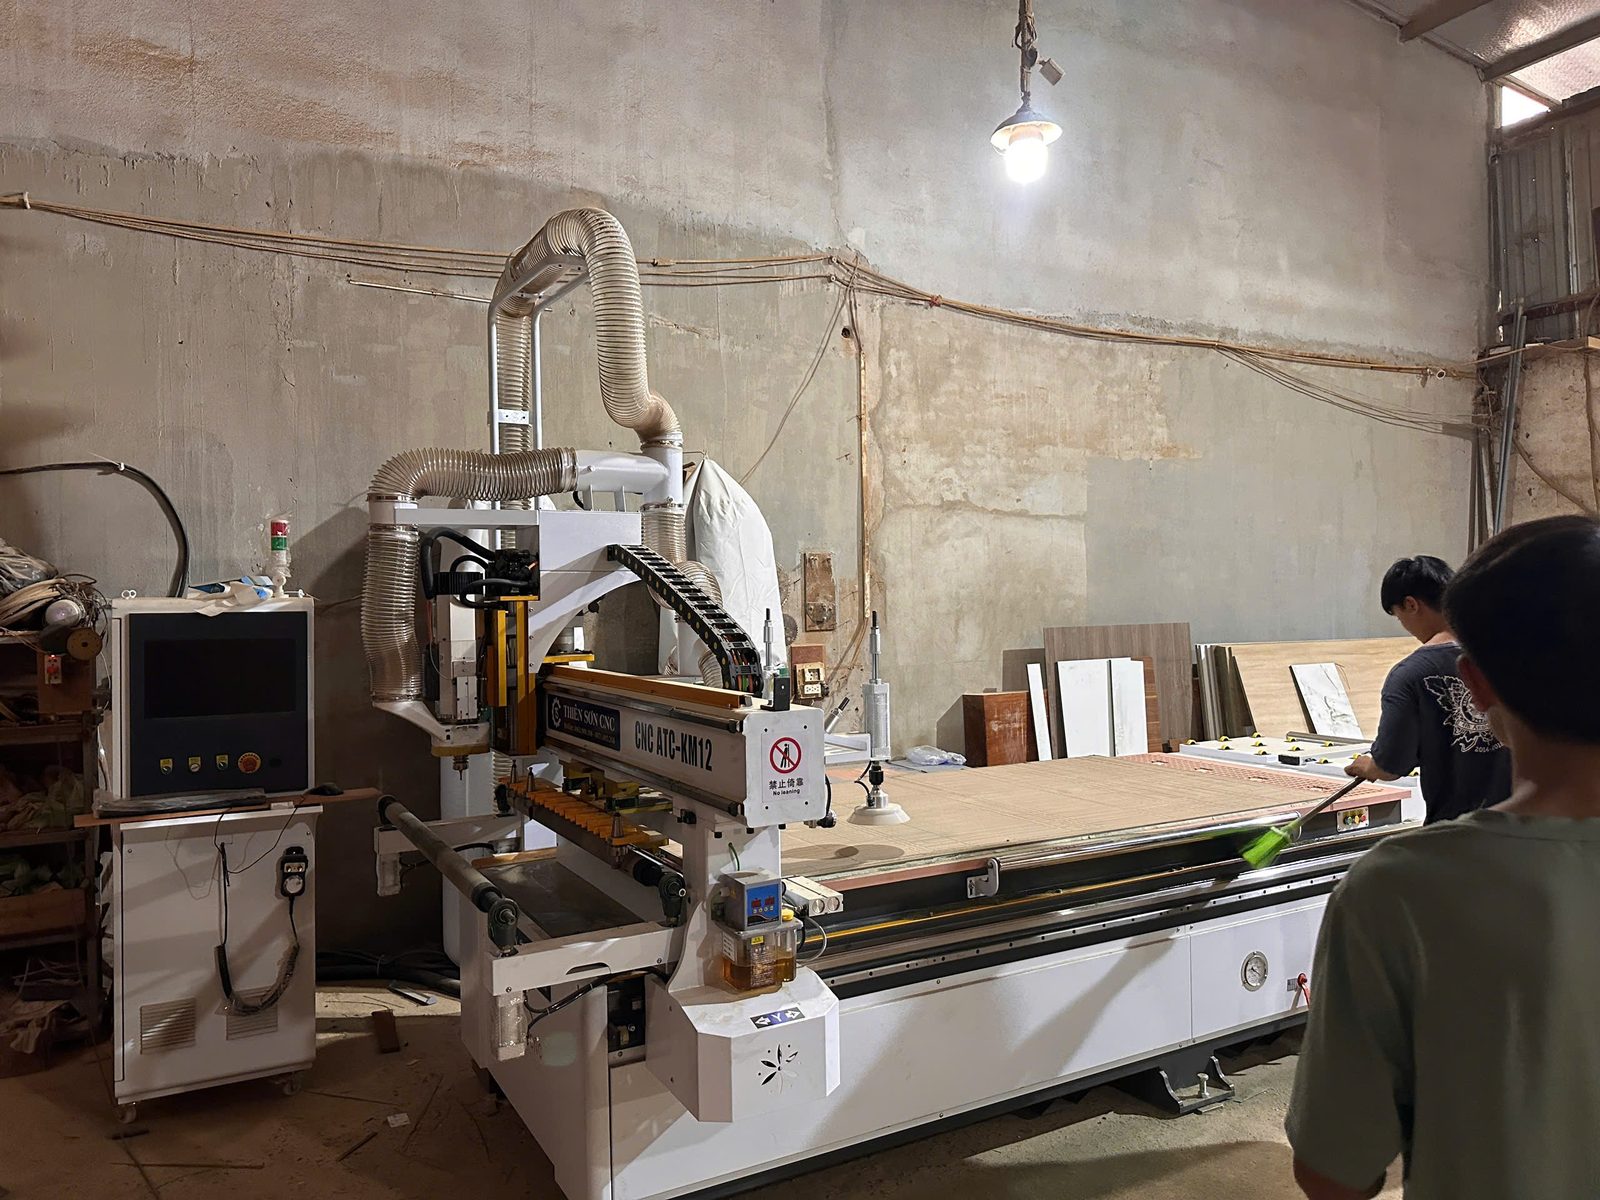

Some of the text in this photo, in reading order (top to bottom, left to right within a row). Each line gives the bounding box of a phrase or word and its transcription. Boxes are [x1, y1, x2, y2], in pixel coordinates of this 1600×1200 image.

[599, 714, 615, 732] CNC
[635, 721, 653, 753] CNC
[657, 727, 713, 771] ATC-KM12
[769, 777, 804, 790] 禁止倚靠
[771, 1012, 782, 1022] Y
